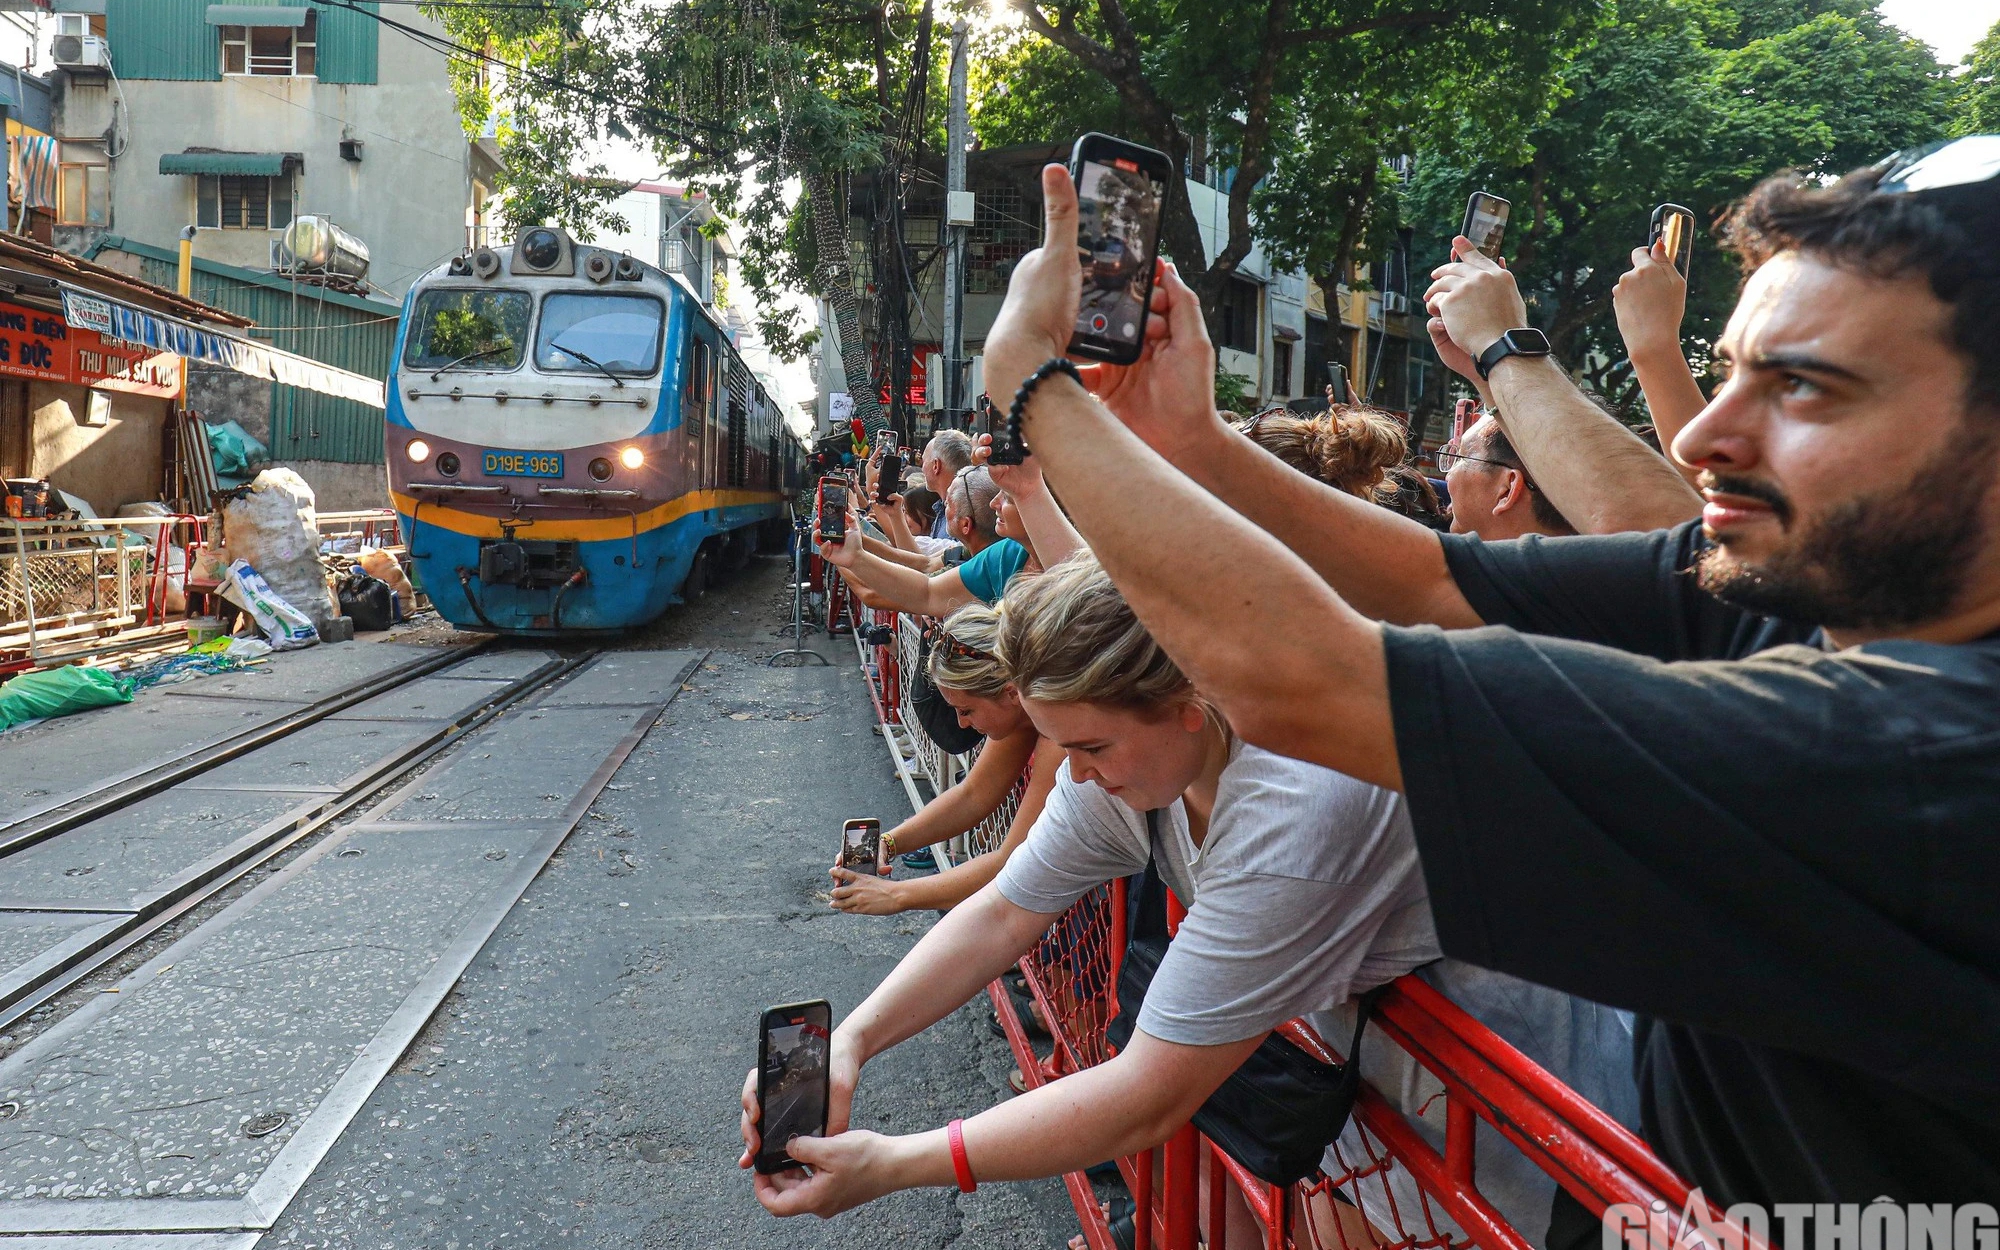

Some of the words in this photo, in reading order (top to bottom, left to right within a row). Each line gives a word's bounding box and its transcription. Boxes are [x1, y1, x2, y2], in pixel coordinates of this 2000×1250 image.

[79, 350, 102, 373] THU
[106, 356, 131, 380] MUA
[133, 355, 154, 383] SẮT
[486, 454, 559, 474] D19E-965
